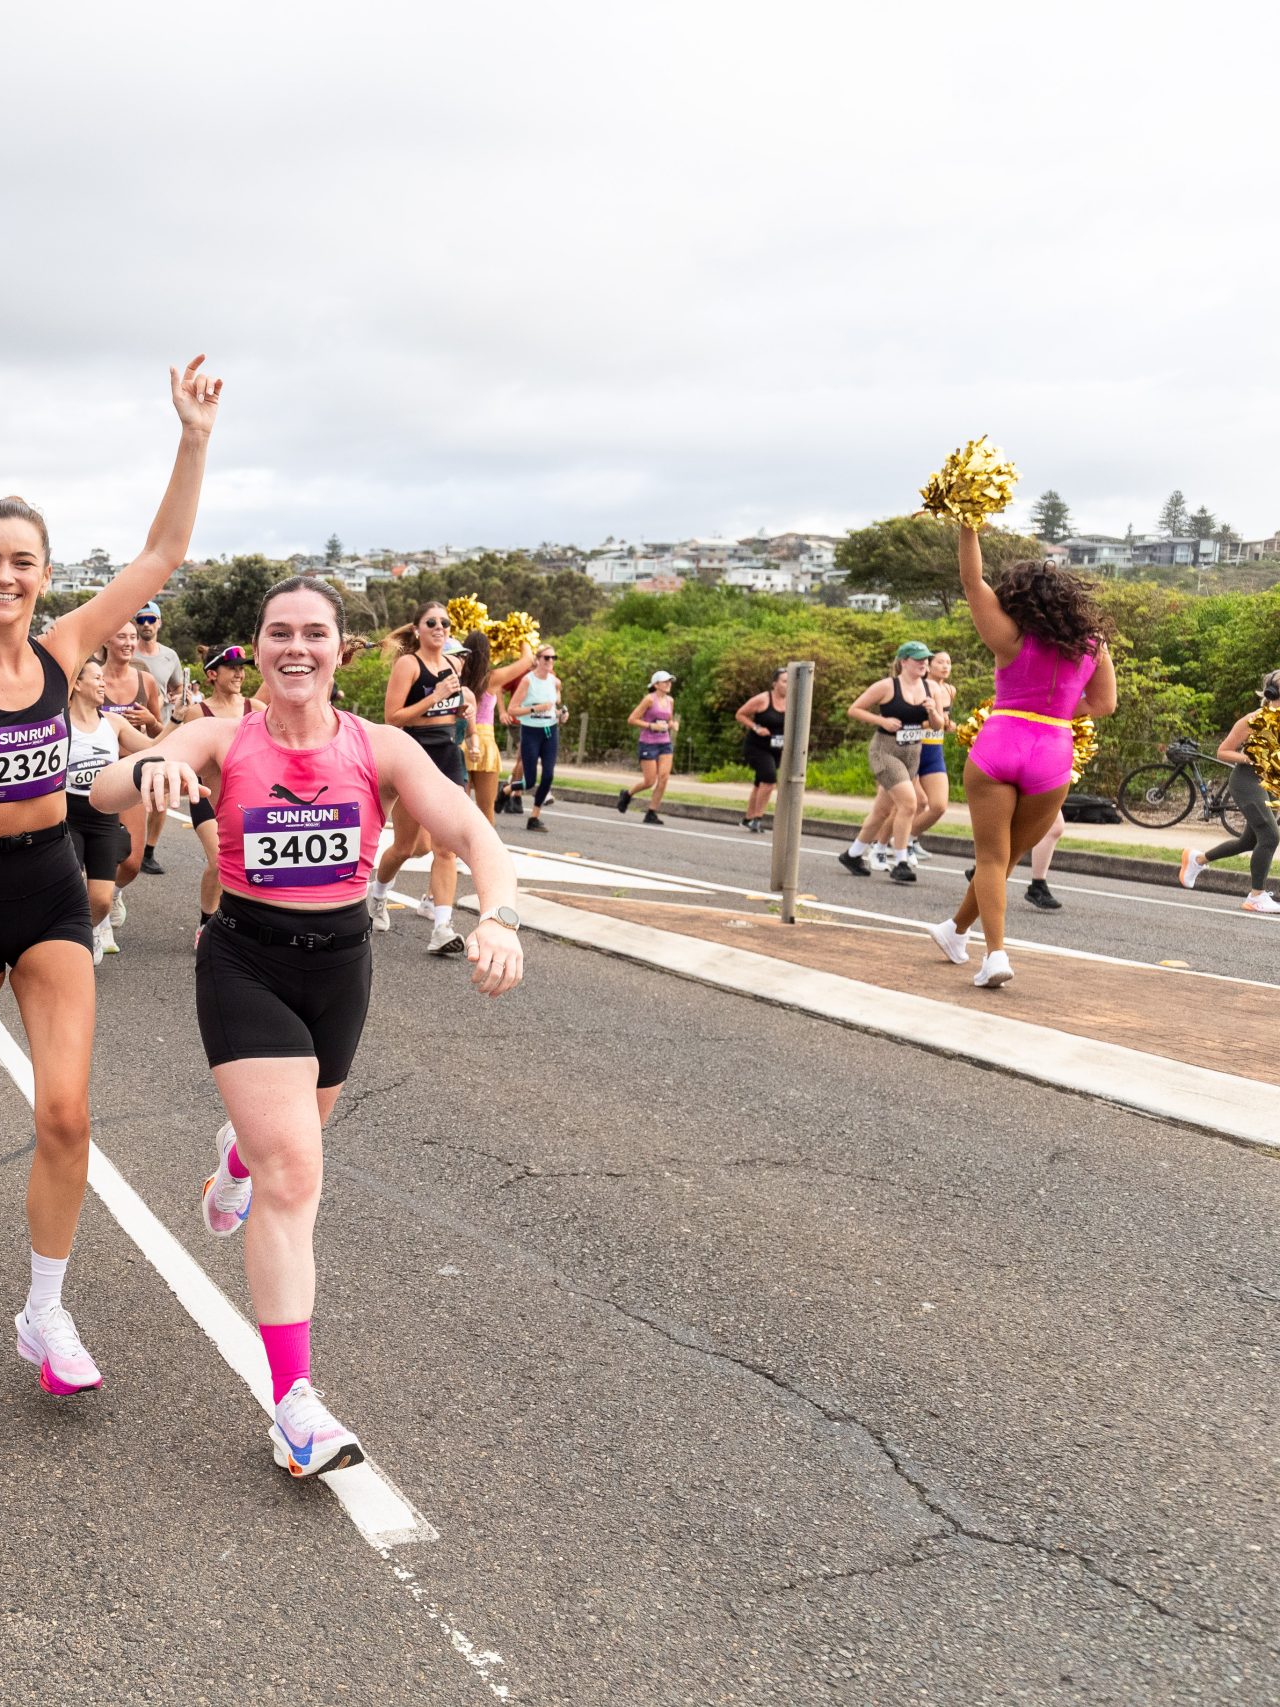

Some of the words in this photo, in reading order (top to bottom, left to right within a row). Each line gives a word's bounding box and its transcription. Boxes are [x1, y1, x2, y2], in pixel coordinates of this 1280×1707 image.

[0, 730, 28, 745] SUN
[29, 724, 52, 741] RUN
[266, 811, 299, 824] SUN
[301, 809, 334, 822] RUN
[257, 832, 349, 866] 3403
